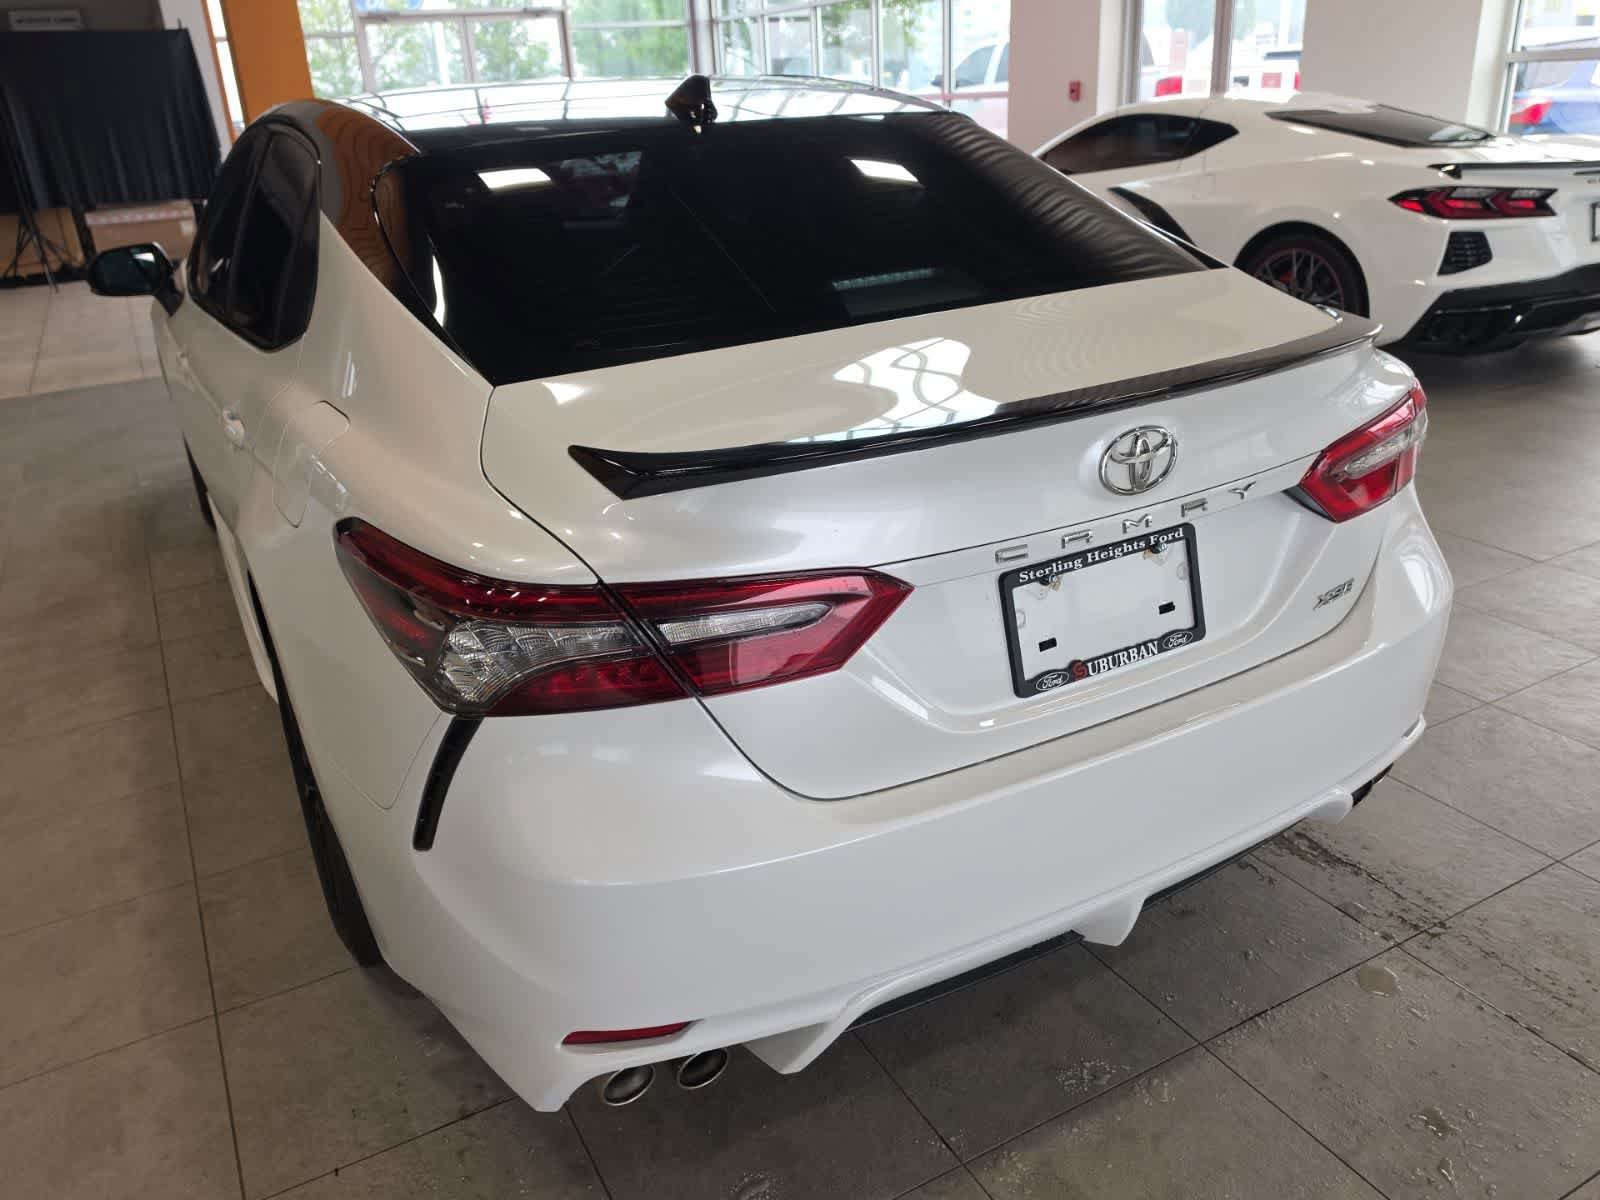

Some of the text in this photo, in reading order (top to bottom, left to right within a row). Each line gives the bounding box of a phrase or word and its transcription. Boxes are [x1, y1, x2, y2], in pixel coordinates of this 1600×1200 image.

[994, 481, 1257, 564] CAMRY
[1018, 527, 1185, 583] Sterling Heights Ford
[1040, 673, 1065, 689] Ford
[1071, 640, 1159, 681] SUBURBAN
